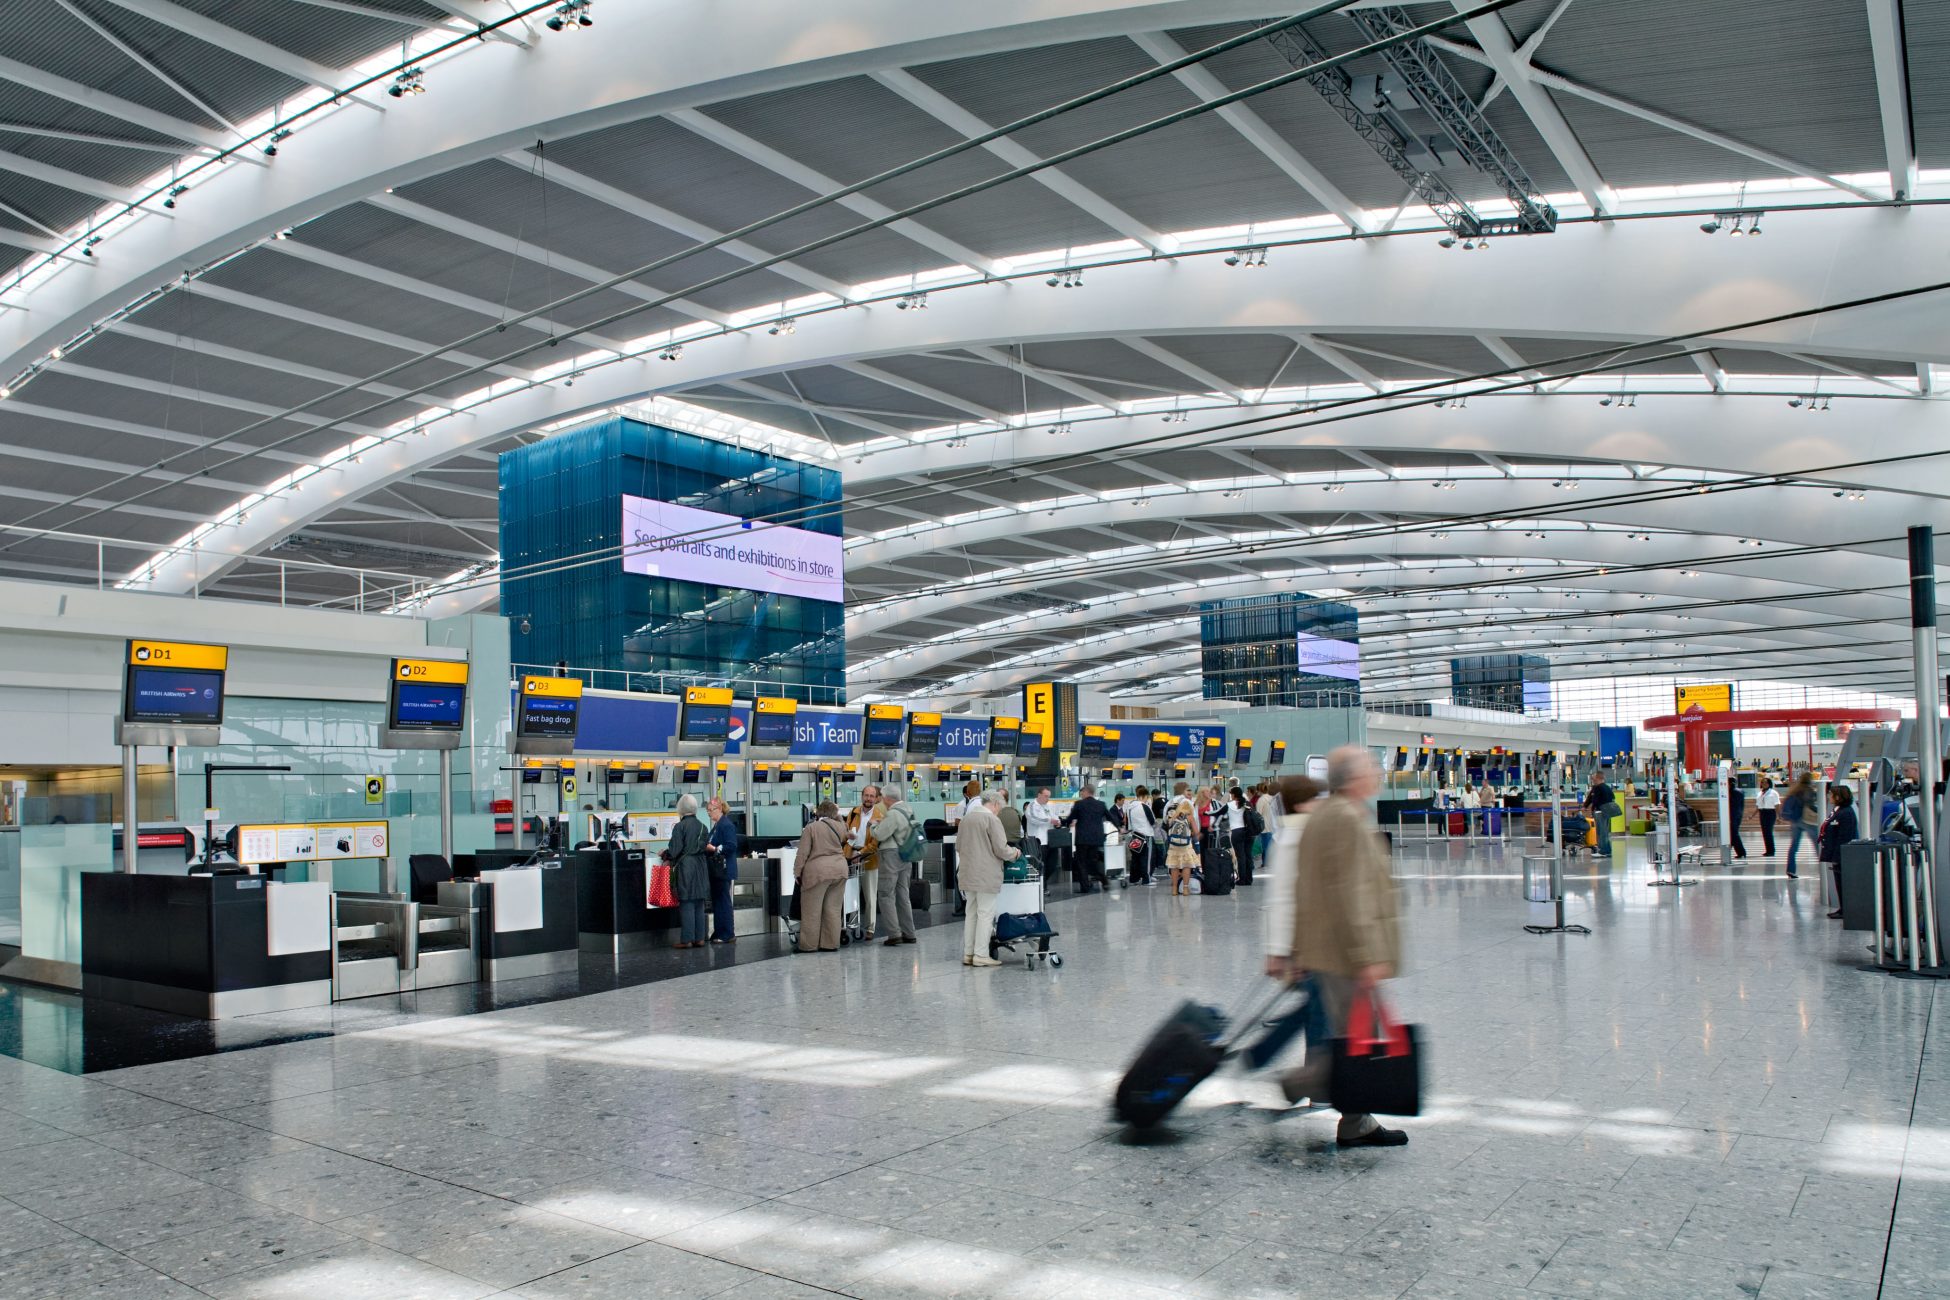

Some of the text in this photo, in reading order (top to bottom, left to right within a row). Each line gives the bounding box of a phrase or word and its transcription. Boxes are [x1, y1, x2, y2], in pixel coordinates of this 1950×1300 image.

[635, 529, 834, 577] See portraits and exhibitions in store
[154, 649, 171, 660] D1
[414, 666, 427, 675] D2
[538, 682, 549, 690] D3
[698, 691, 706, 699] D4
[1035, 693, 1045, 713] E
[526, 714, 571, 725] Fast bag drop
[793, 721, 858, 743] ish Team
[946, 728, 961, 746] of
